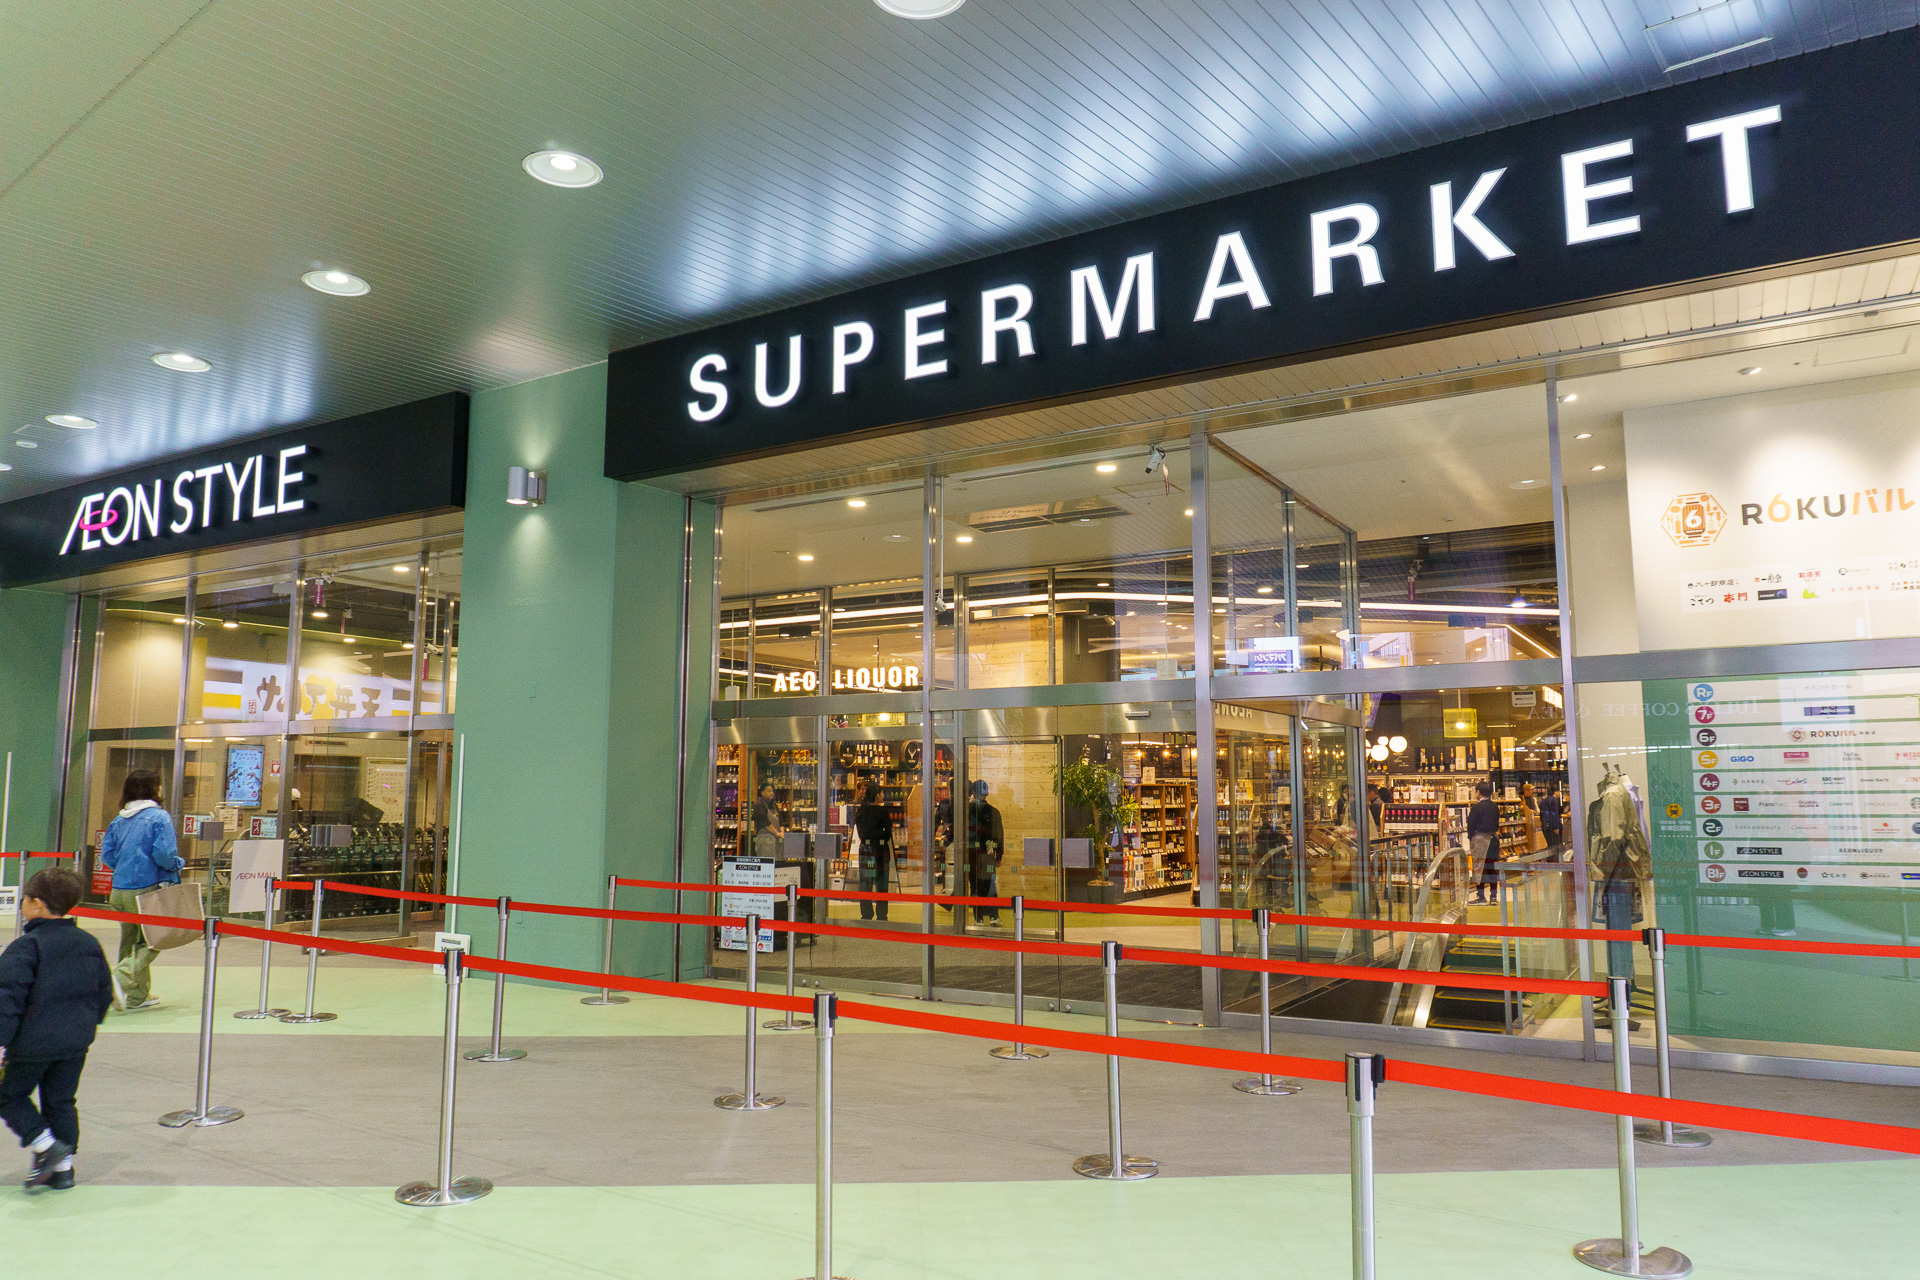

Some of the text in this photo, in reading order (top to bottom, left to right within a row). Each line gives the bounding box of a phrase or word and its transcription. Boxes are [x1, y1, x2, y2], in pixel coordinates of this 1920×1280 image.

[687, 104, 1783, 424] SUPERMARKET
[169, 445, 307, 534] STYLE
[834, 665, 920, 689] LIQUOR
[1697, 709, 1713, 720] 7F
[1699, 732, 1716, 743] 6F
[1700, 754, 1717, 765] 5F
[1702, 777, 1719, 788] 4F
[1703, 799, 1720, 811] 3F
[1705, 822, 1722, 833] 2F
[1709, 845, 1720, 856] 1F
[1707, 868, 1725, 879] B1F
